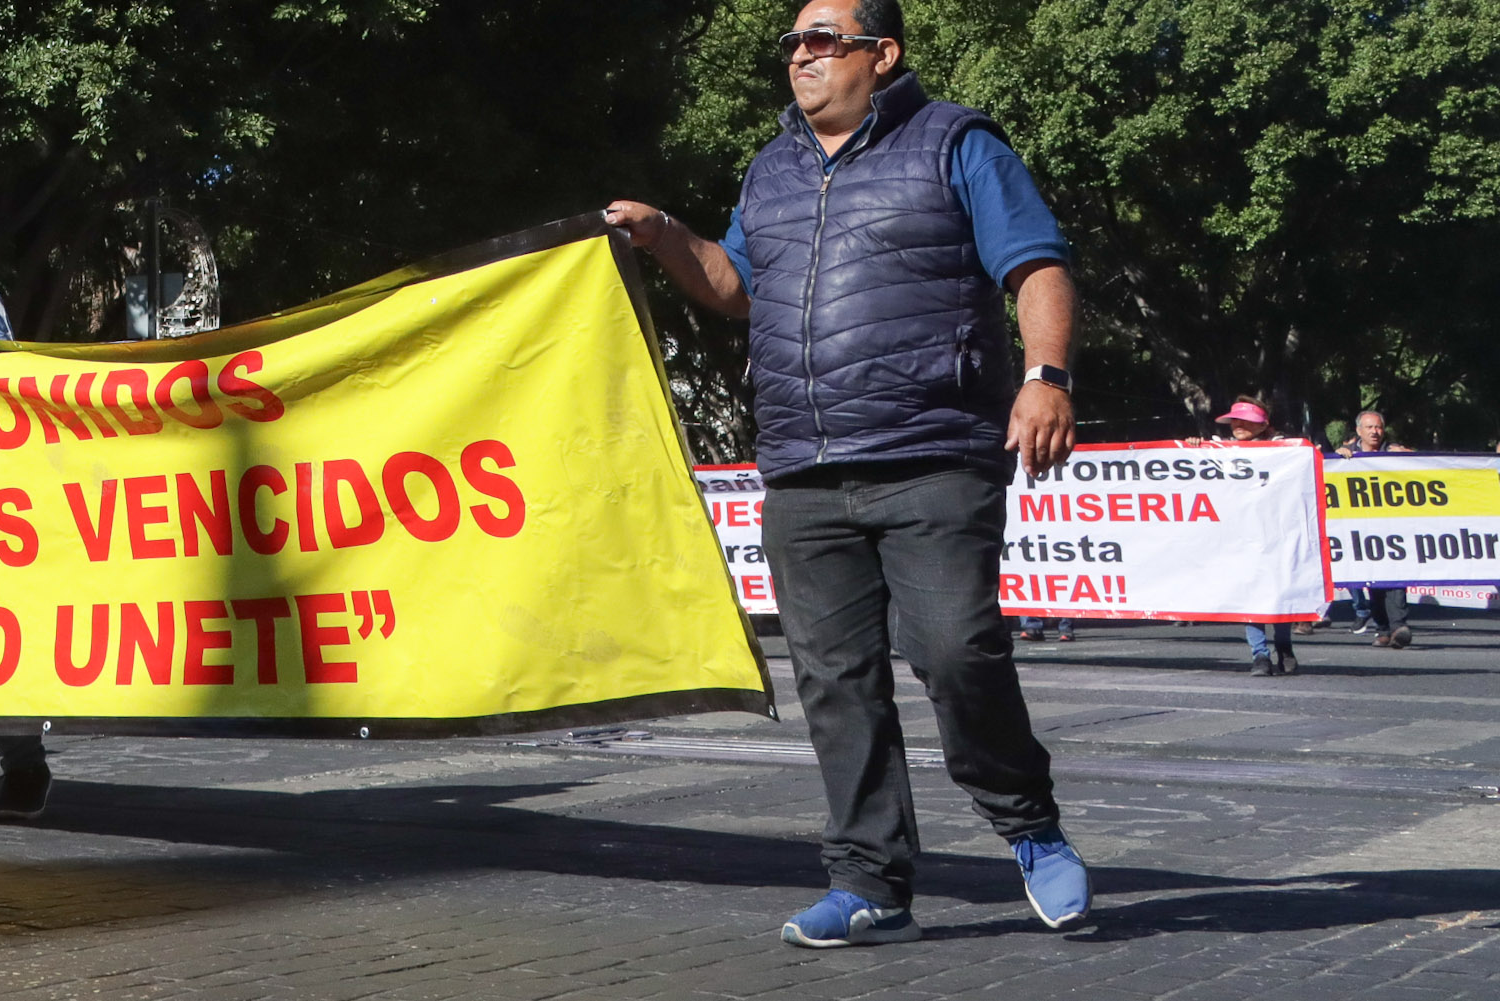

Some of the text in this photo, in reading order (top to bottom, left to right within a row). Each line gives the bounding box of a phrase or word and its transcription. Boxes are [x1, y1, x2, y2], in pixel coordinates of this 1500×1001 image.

[1026, 459, 1269, 489] promesas,
[63, 440, 525, 562] VENCIDOS
[1019, 493, 1220, 522] MISERIA
[1347, 477, 1448, 508] Ricos
[1351, 531, 1407, 562] los
